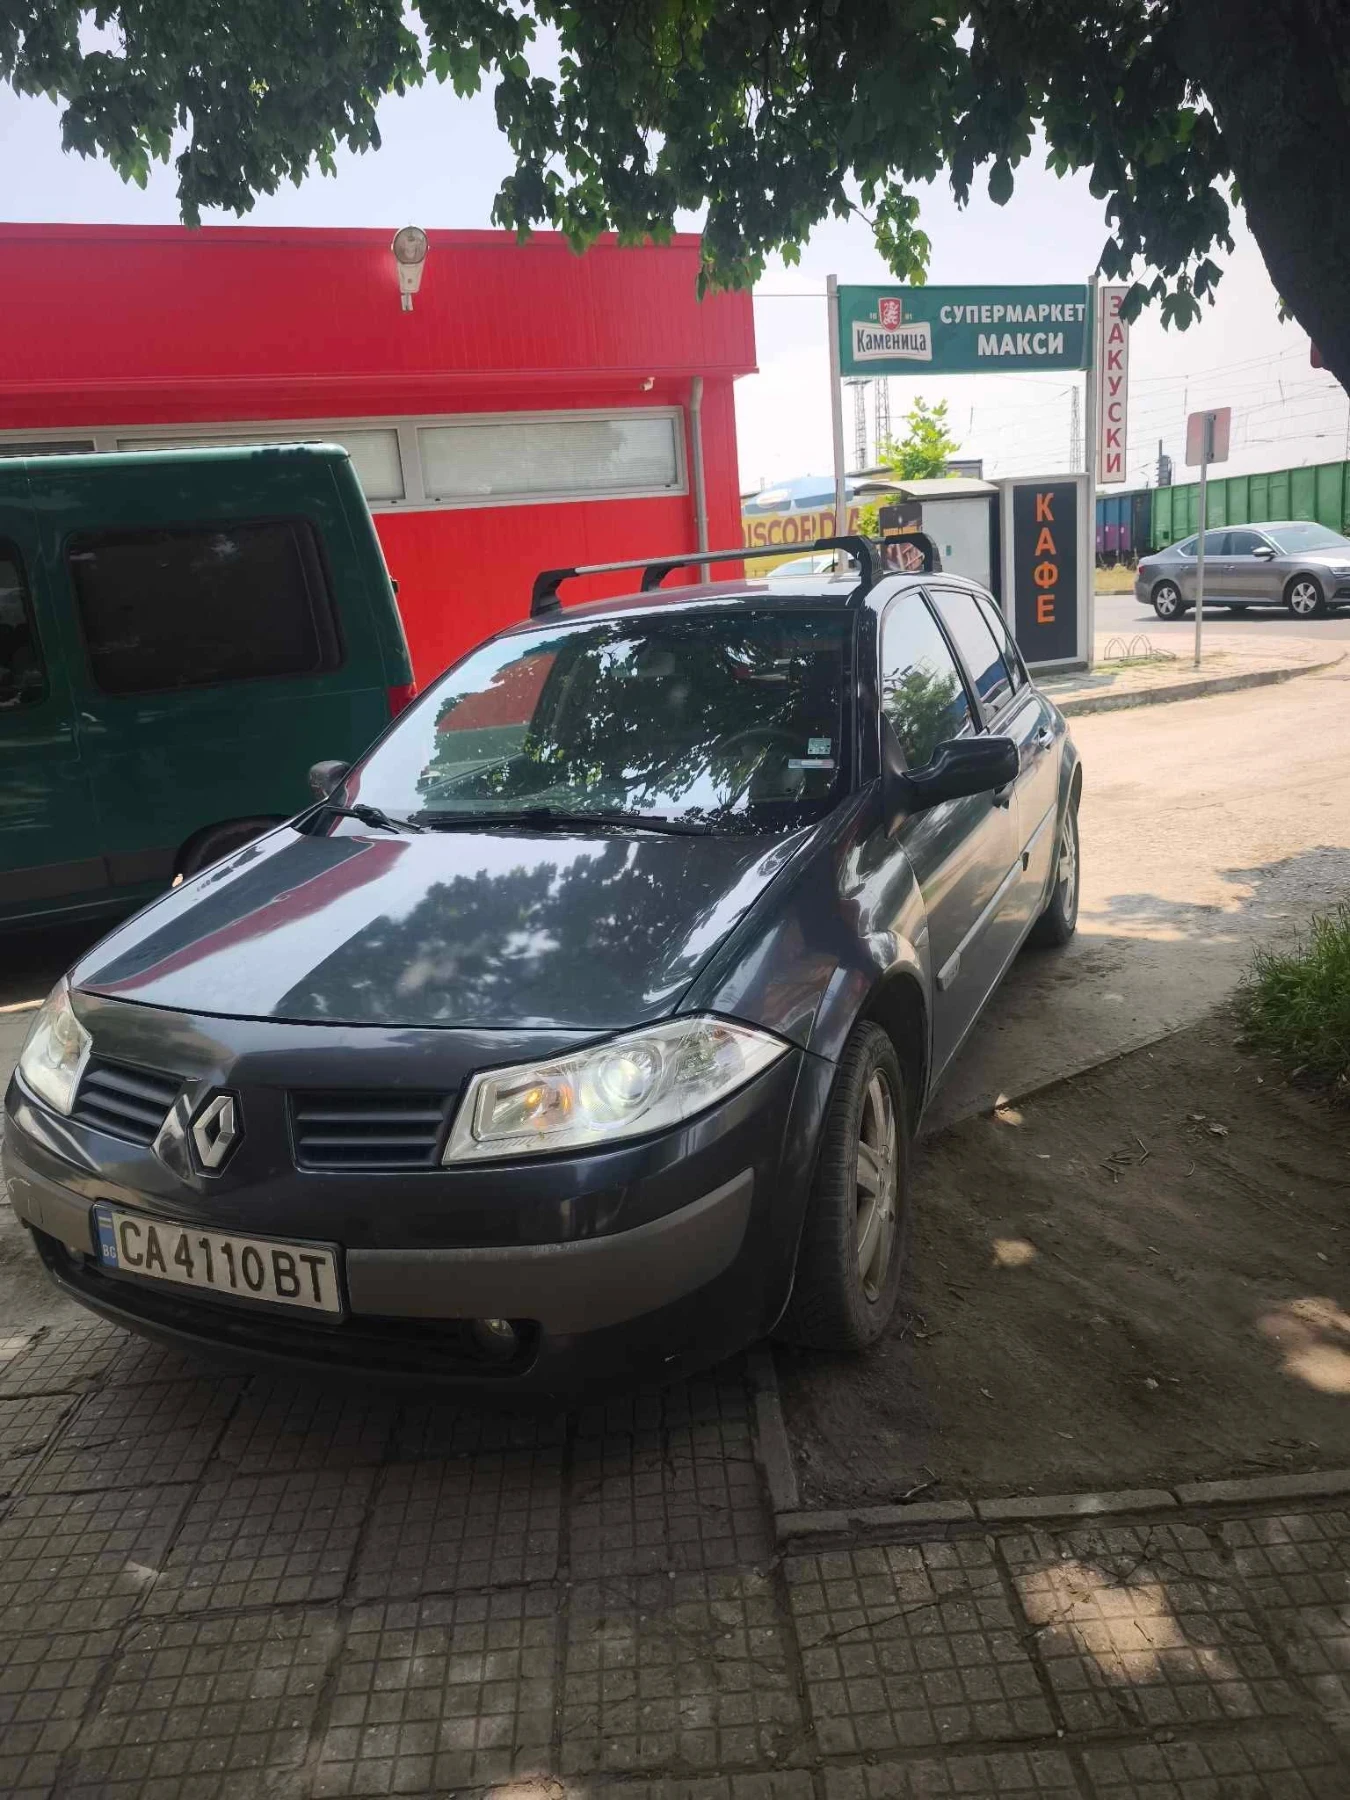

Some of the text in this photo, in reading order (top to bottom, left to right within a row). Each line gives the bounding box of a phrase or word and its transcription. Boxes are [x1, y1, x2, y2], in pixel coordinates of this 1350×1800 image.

[940, 303, 1085, 324] СУПЕРМАРКЕТ
[857, 329, 927, 353] Каменица
[977, 332, 1064, 356] МАКСИ
[1106, 295, 1124, 474] ЗАКУСКИ
[1034, 492, 1059, 623] КАФЕ
[102, 1244, 117, 1259] BG
